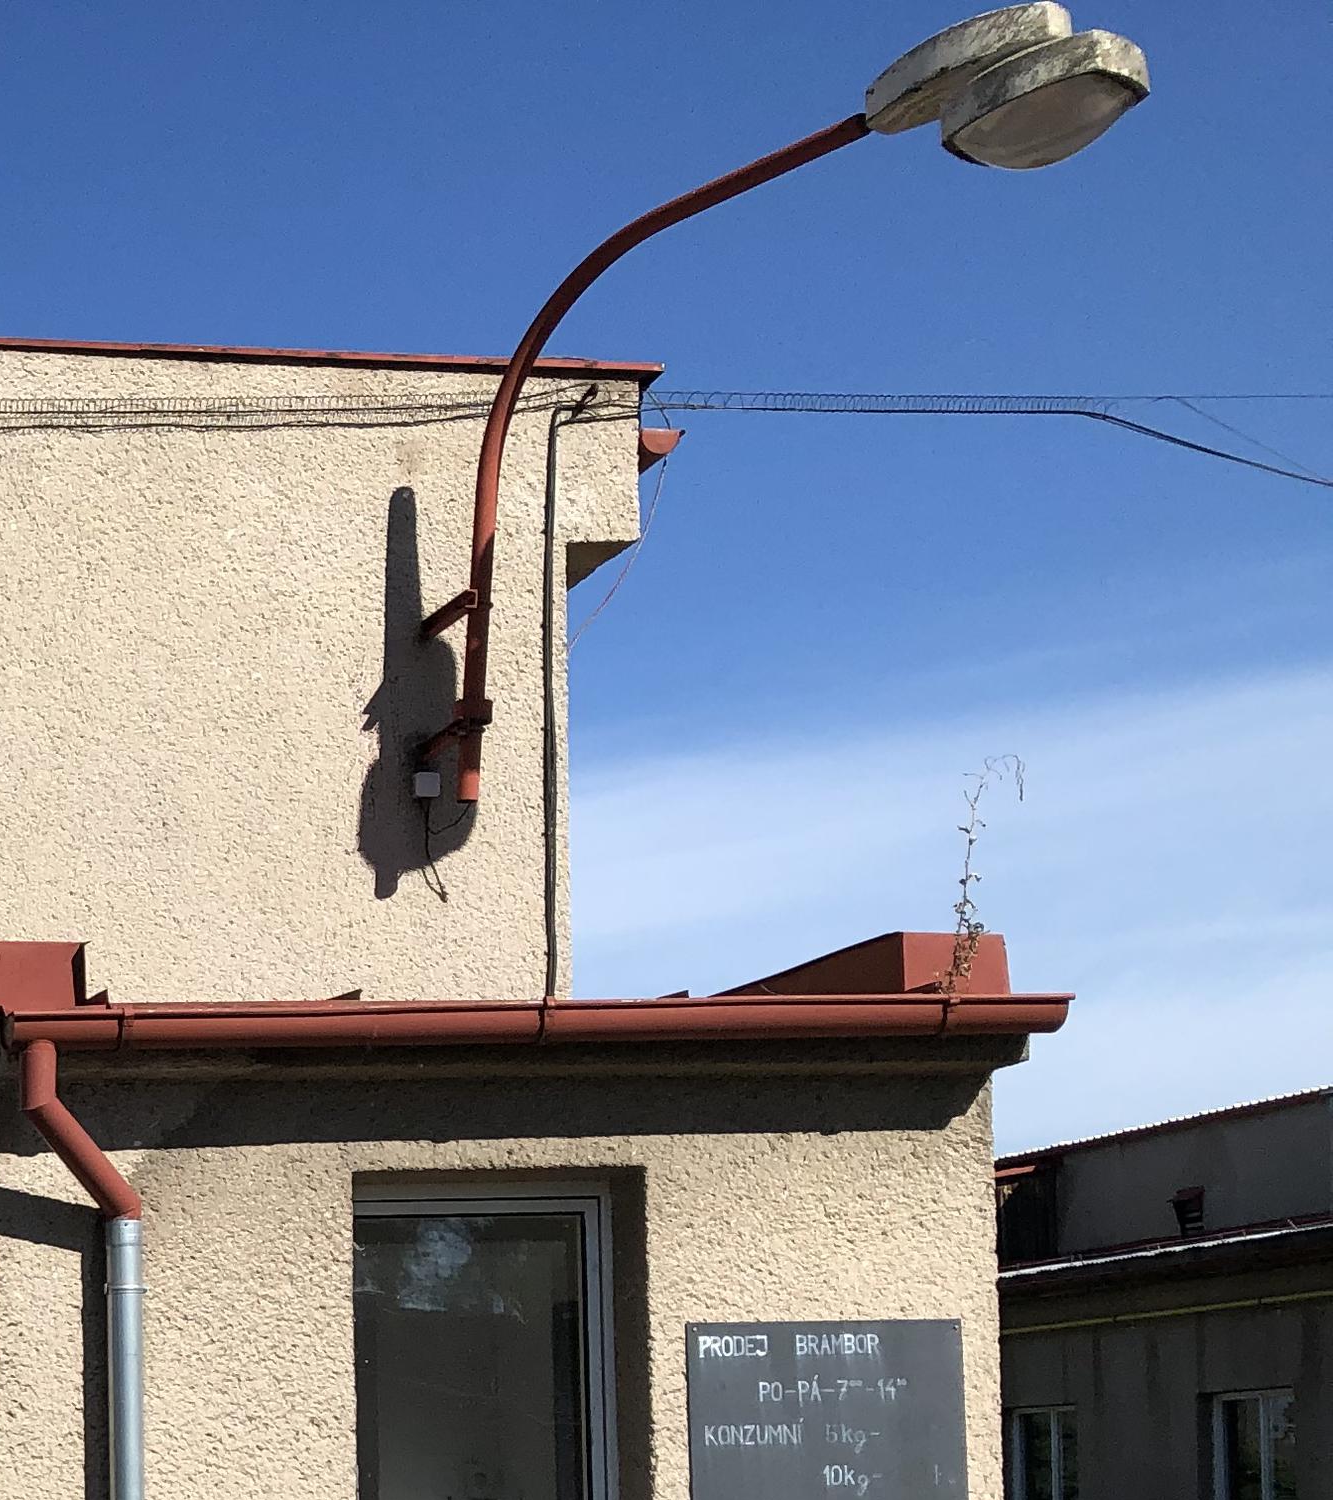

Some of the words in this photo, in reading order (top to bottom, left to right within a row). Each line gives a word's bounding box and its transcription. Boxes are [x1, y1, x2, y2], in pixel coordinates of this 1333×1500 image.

[699, 1334, 768, 1358] PRODEJ
[795, 1333, 881, 1356] BRAMBOR
[704, 1418, 805, 1447] KONZUMNÍ
